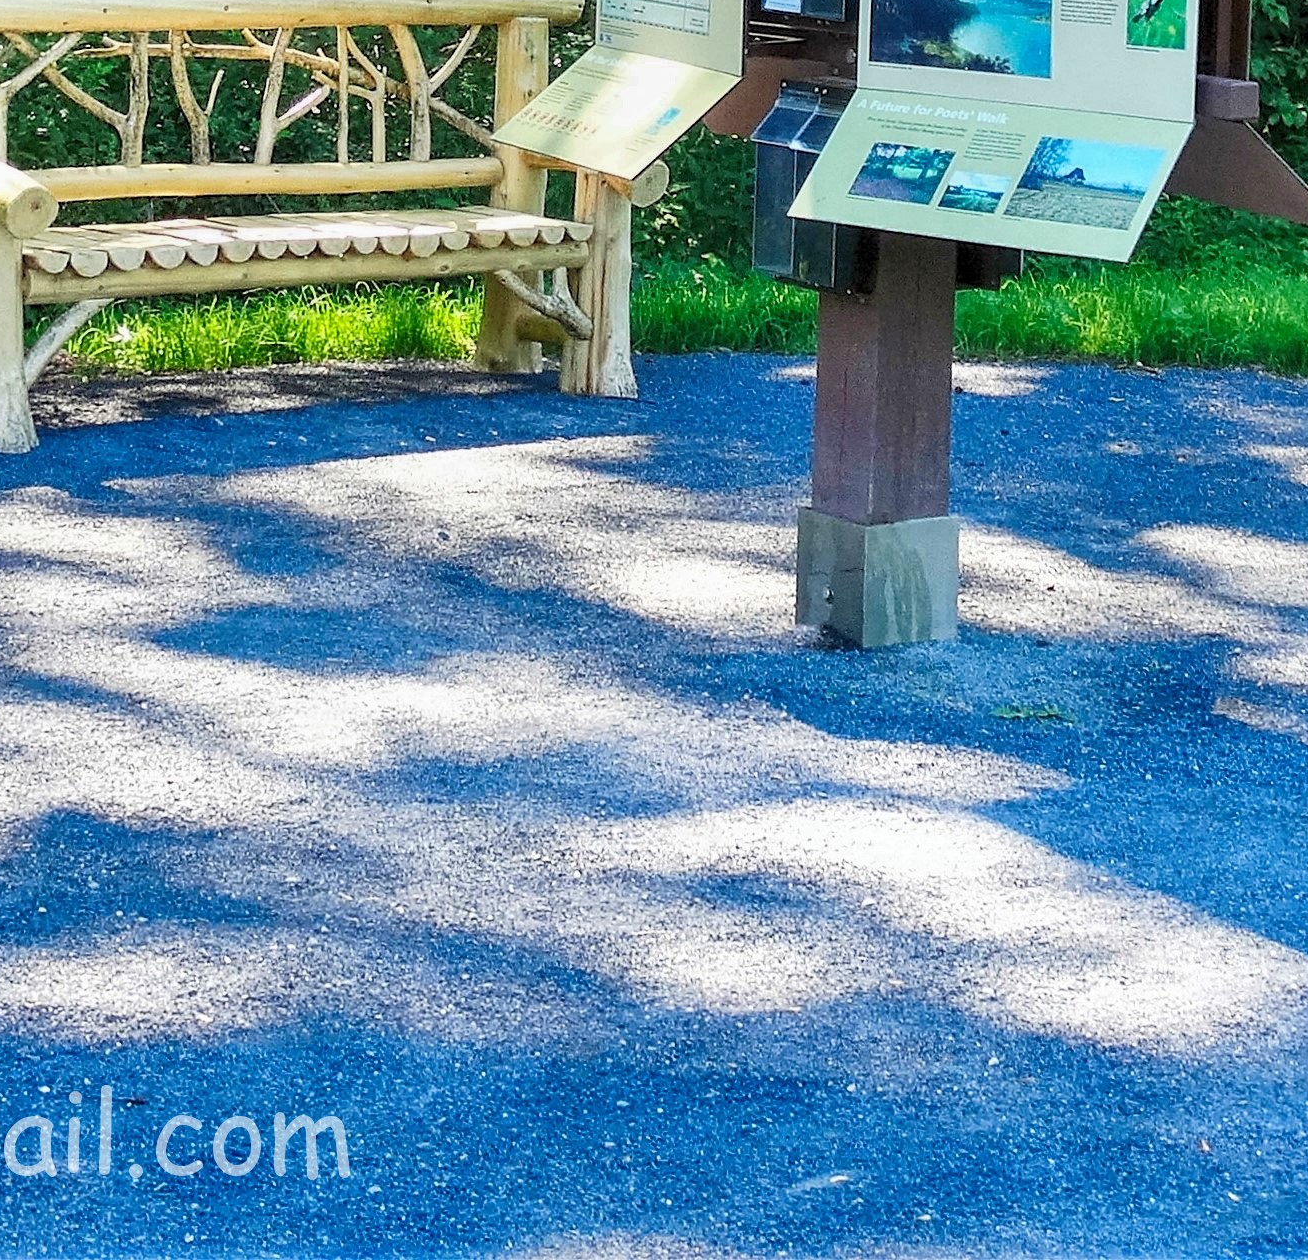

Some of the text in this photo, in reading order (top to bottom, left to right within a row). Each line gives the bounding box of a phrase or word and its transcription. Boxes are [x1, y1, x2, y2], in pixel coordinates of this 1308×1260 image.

[857, 98, 1009, 125] A Future for Poets' Walk
